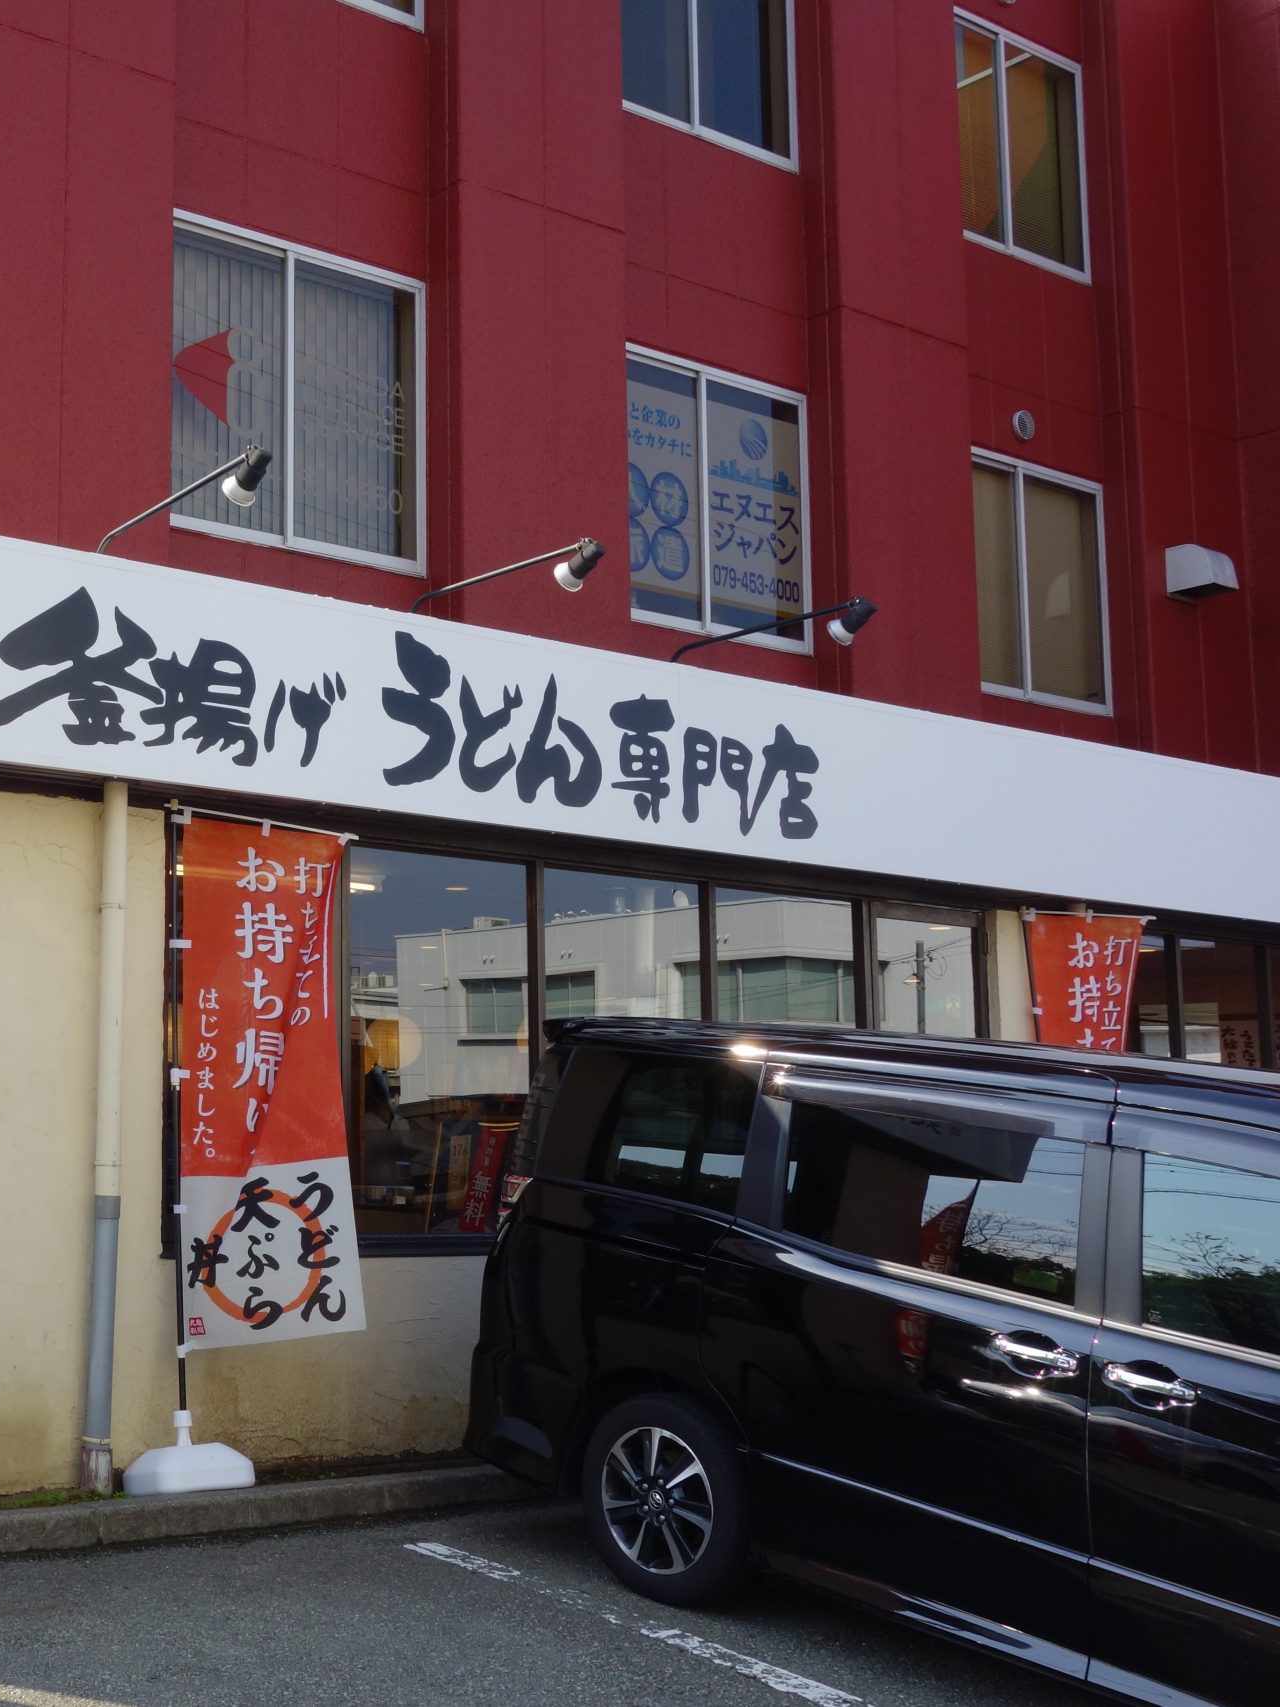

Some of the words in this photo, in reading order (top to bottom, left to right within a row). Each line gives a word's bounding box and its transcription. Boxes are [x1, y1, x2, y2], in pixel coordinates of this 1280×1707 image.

[628, 427, 693, 458] をカタチに
[710, 490, 800, 535] エヌエス
[712, 521, 797, 565] ジャパン
[713, 564, 800, 603] 079-453-4000
[192, 987, 220, 1158] はじめました。
[464, 1170, 491, 1226] 無料
[187, 1234, 229, 1289] 丼
[230, 1177, 283, 1330] 天ぷら
[289, 1171, 346, 1322] うどん
